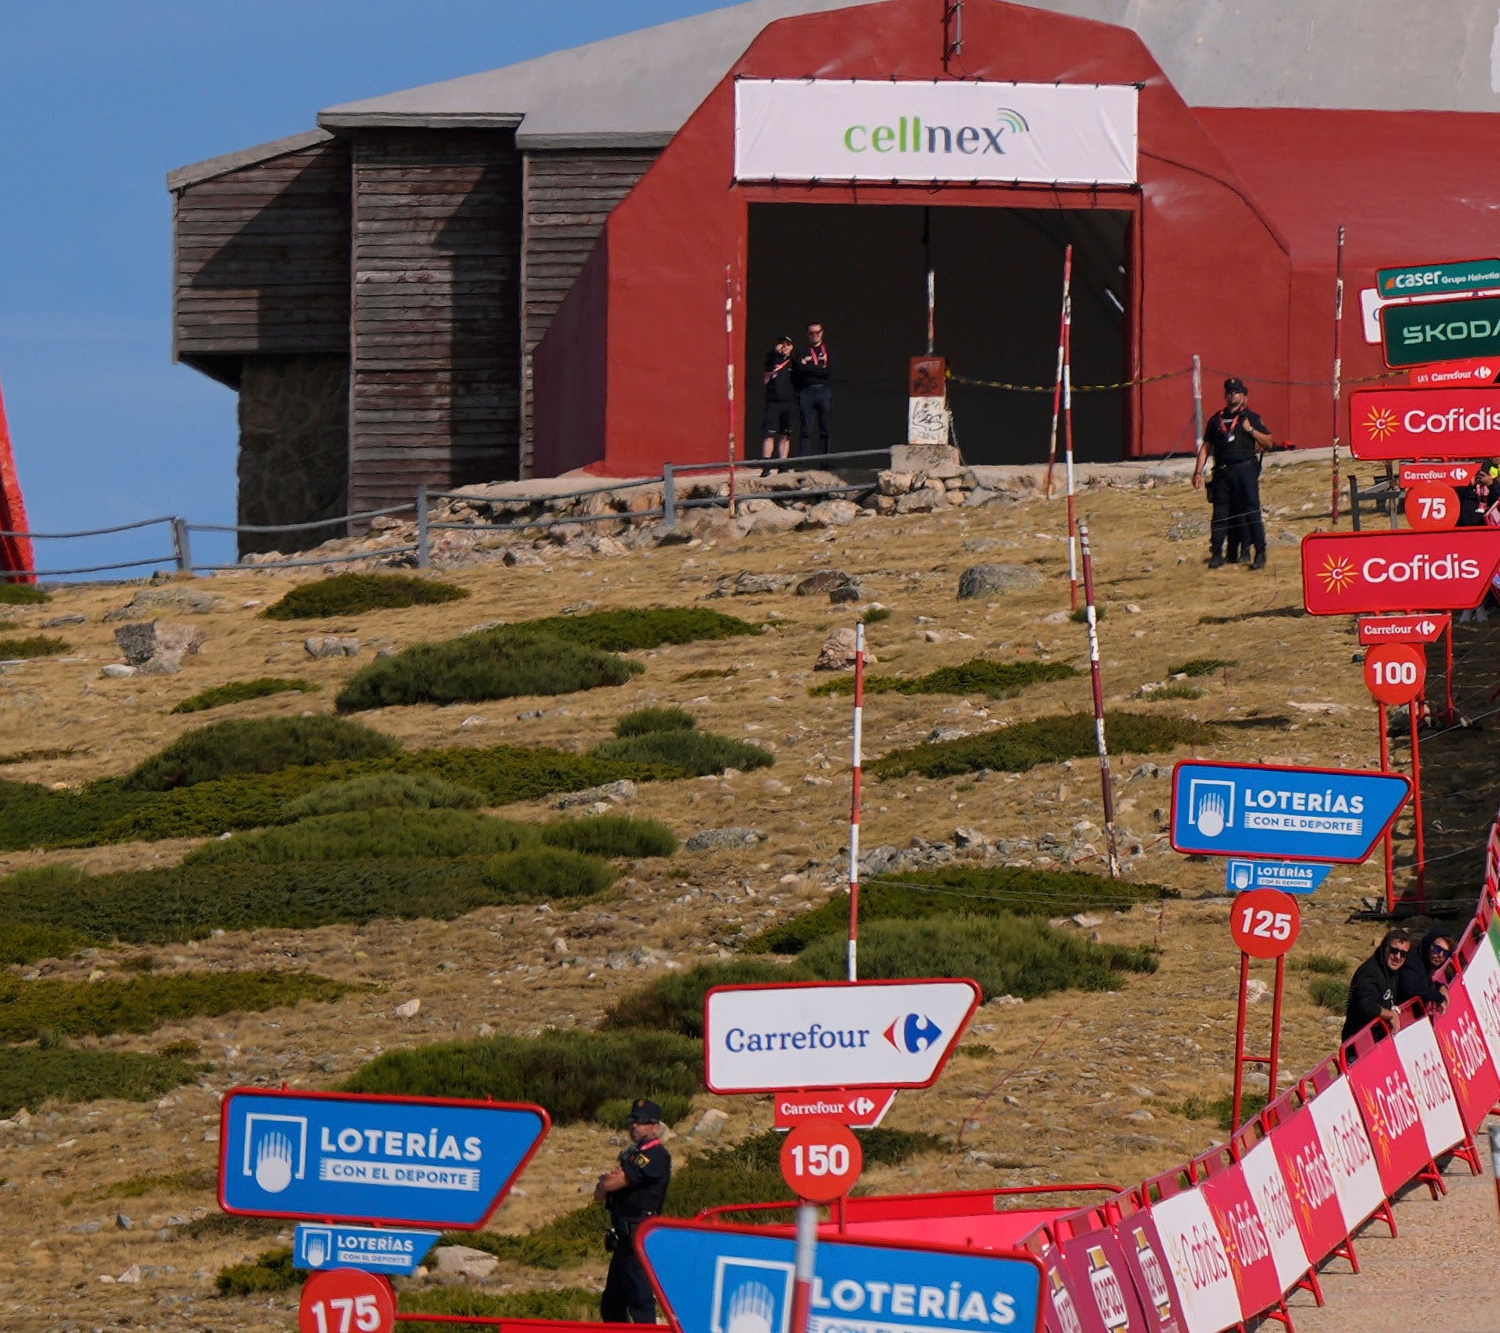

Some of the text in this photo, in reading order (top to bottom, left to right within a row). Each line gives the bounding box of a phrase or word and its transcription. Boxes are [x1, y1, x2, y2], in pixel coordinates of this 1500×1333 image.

[844, 116, 1006, 155] cellnex
[1395, 271, 1442, 288] caser
[1431, 370, 1472, 382] Carrefour
[1404, 469, 1448, 481] Carrefour
[1417, 497, 1447, 519] 75
[1362, 553, 1480, 583] Cofidis
[1364, 623, 1412, 635] Carrefour
[1372, 661, 1417, 685] 100
[1244, 788, 1364, 814] LOTERÍAS
[1253, 816, 1353, 832] CON EL DEPORTE
[1257, 865, 1313, 879] LOTERÍAS
[1242, 907, 1292, 940] 125
[725, 1024, 870, 1053] Carrefour
[1451, 1011, 1487, 1081] Cofidis
[781, 1100, 844, 1115] Carrefour
[1376, 1070, 1418, 1139] Cofidis
[321, 1127, 482, 1162] LOTERÍAS
[791, 1144, 850, 1176] 150
[332, 1163, 468, 1186] CON EL DEPORTE
[1296, 1141, 1336, 1209] Cofidis
[337, 1235, 414, 1251] LOTERÍAS
[1228, 1200, 1269, 1267] Cofidis
[343, 1253, 407, 1264] CON EL DEPORTE
[1181, 1222, 1228, 1290] Cofidis
[311, 1294, 381, 1333] 175
[811, 1276, 1016, 1325] LOTERÍAS
